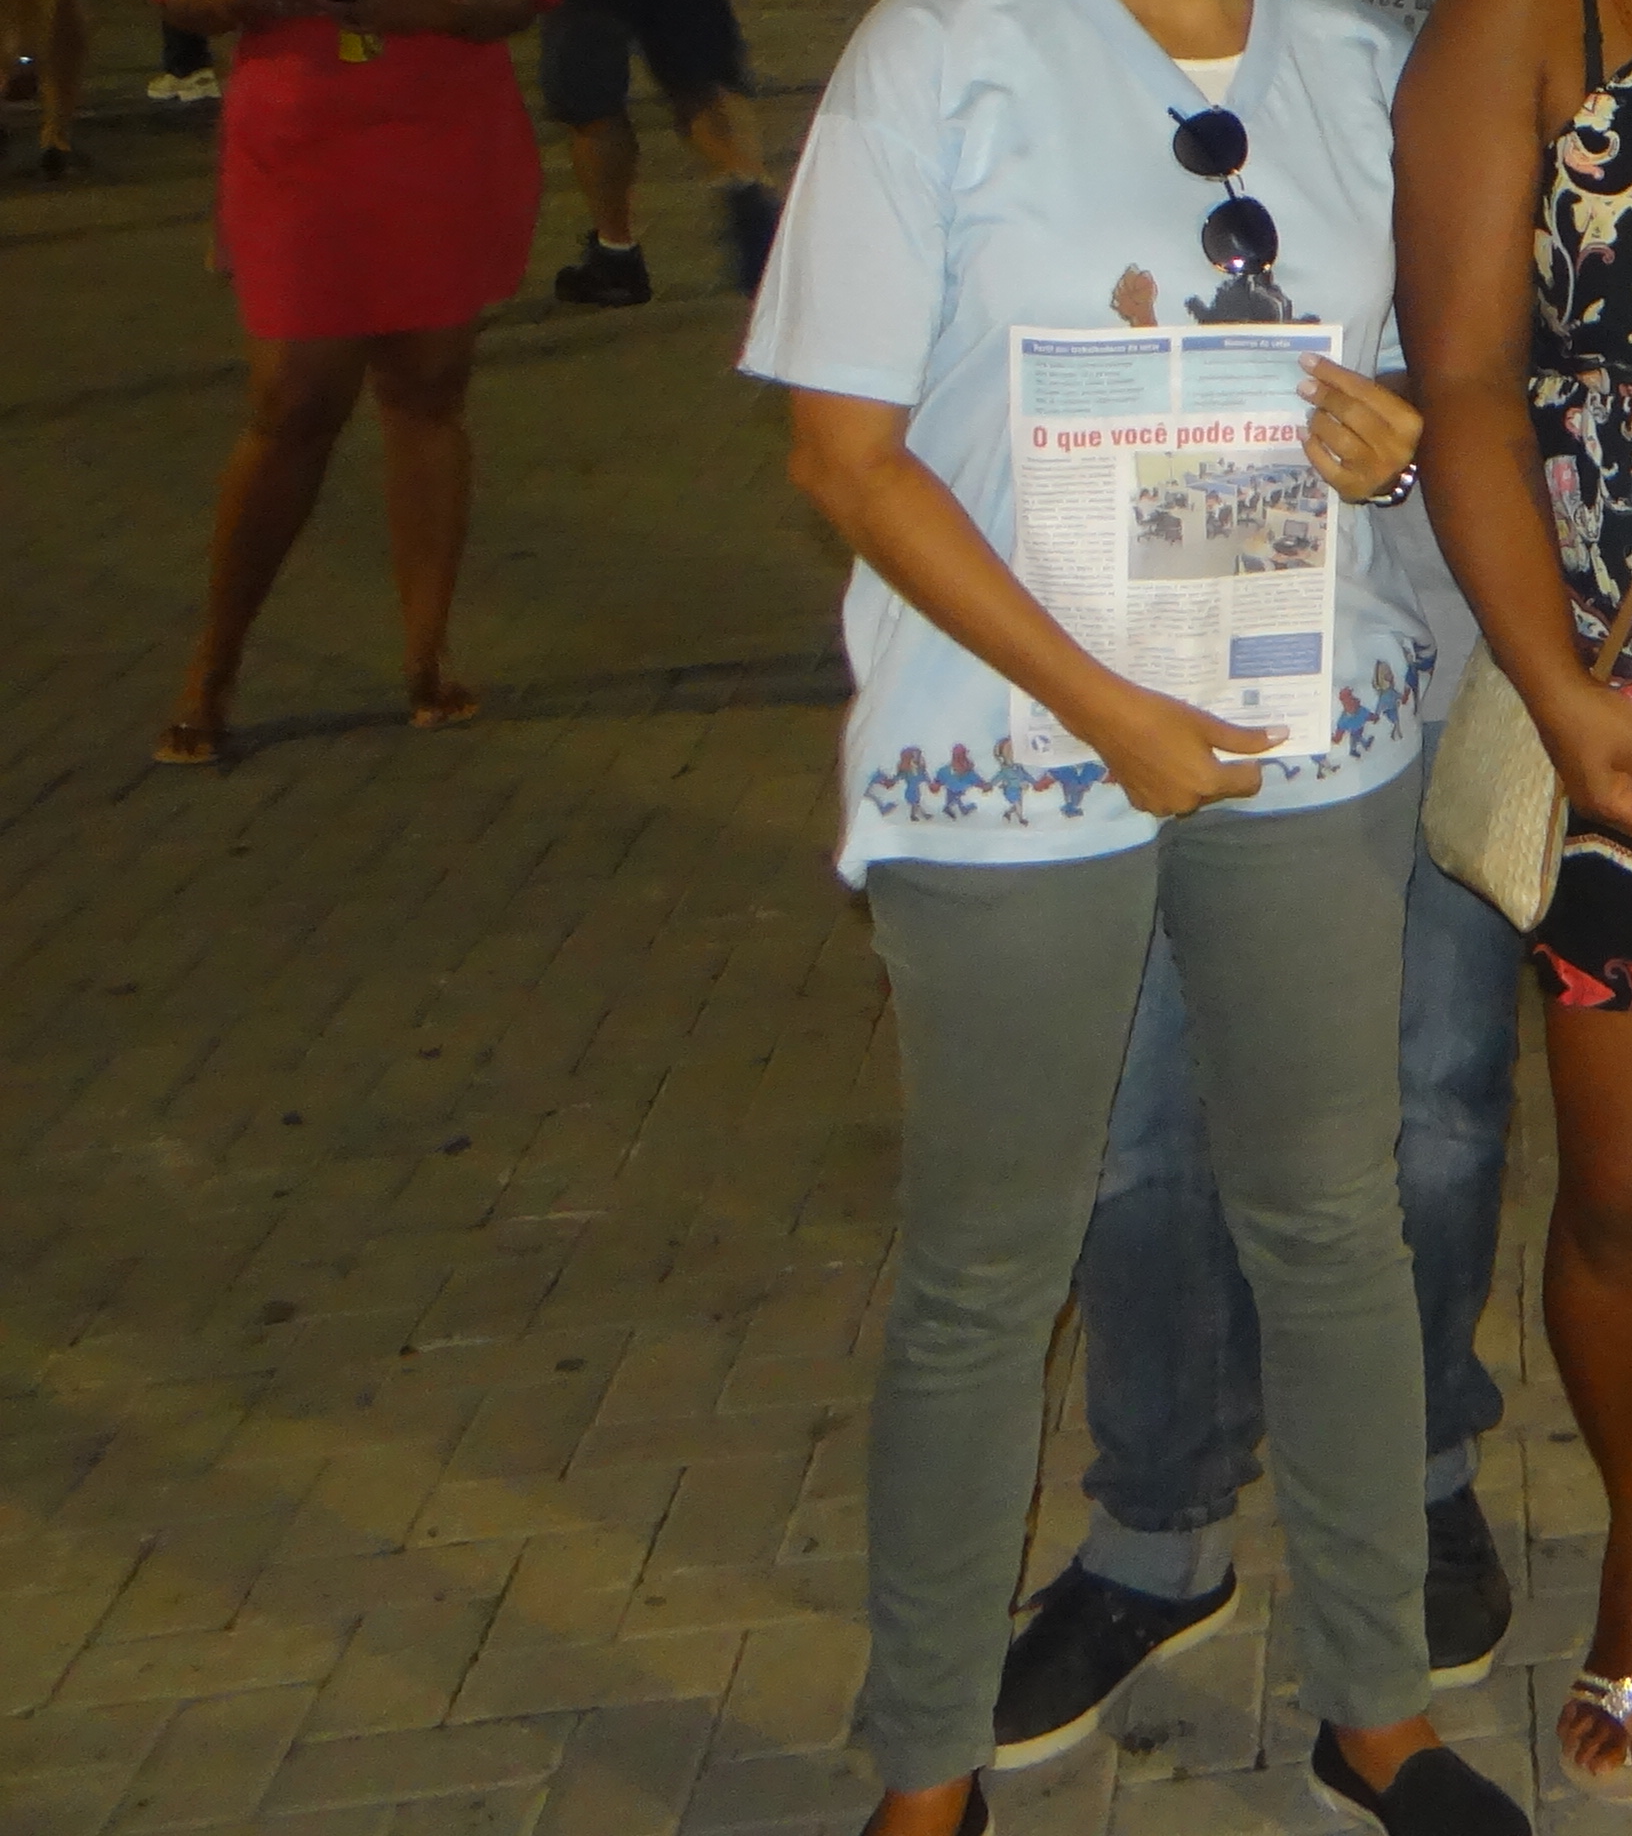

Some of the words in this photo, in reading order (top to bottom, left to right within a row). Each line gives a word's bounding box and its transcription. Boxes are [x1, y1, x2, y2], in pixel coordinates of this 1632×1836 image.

[1033, 425, 1047, 447] O
[1057, 429, 1102, 452] que
[1111, 422, 1168, 446] você
[1176, 420, 1235, 449] pode
